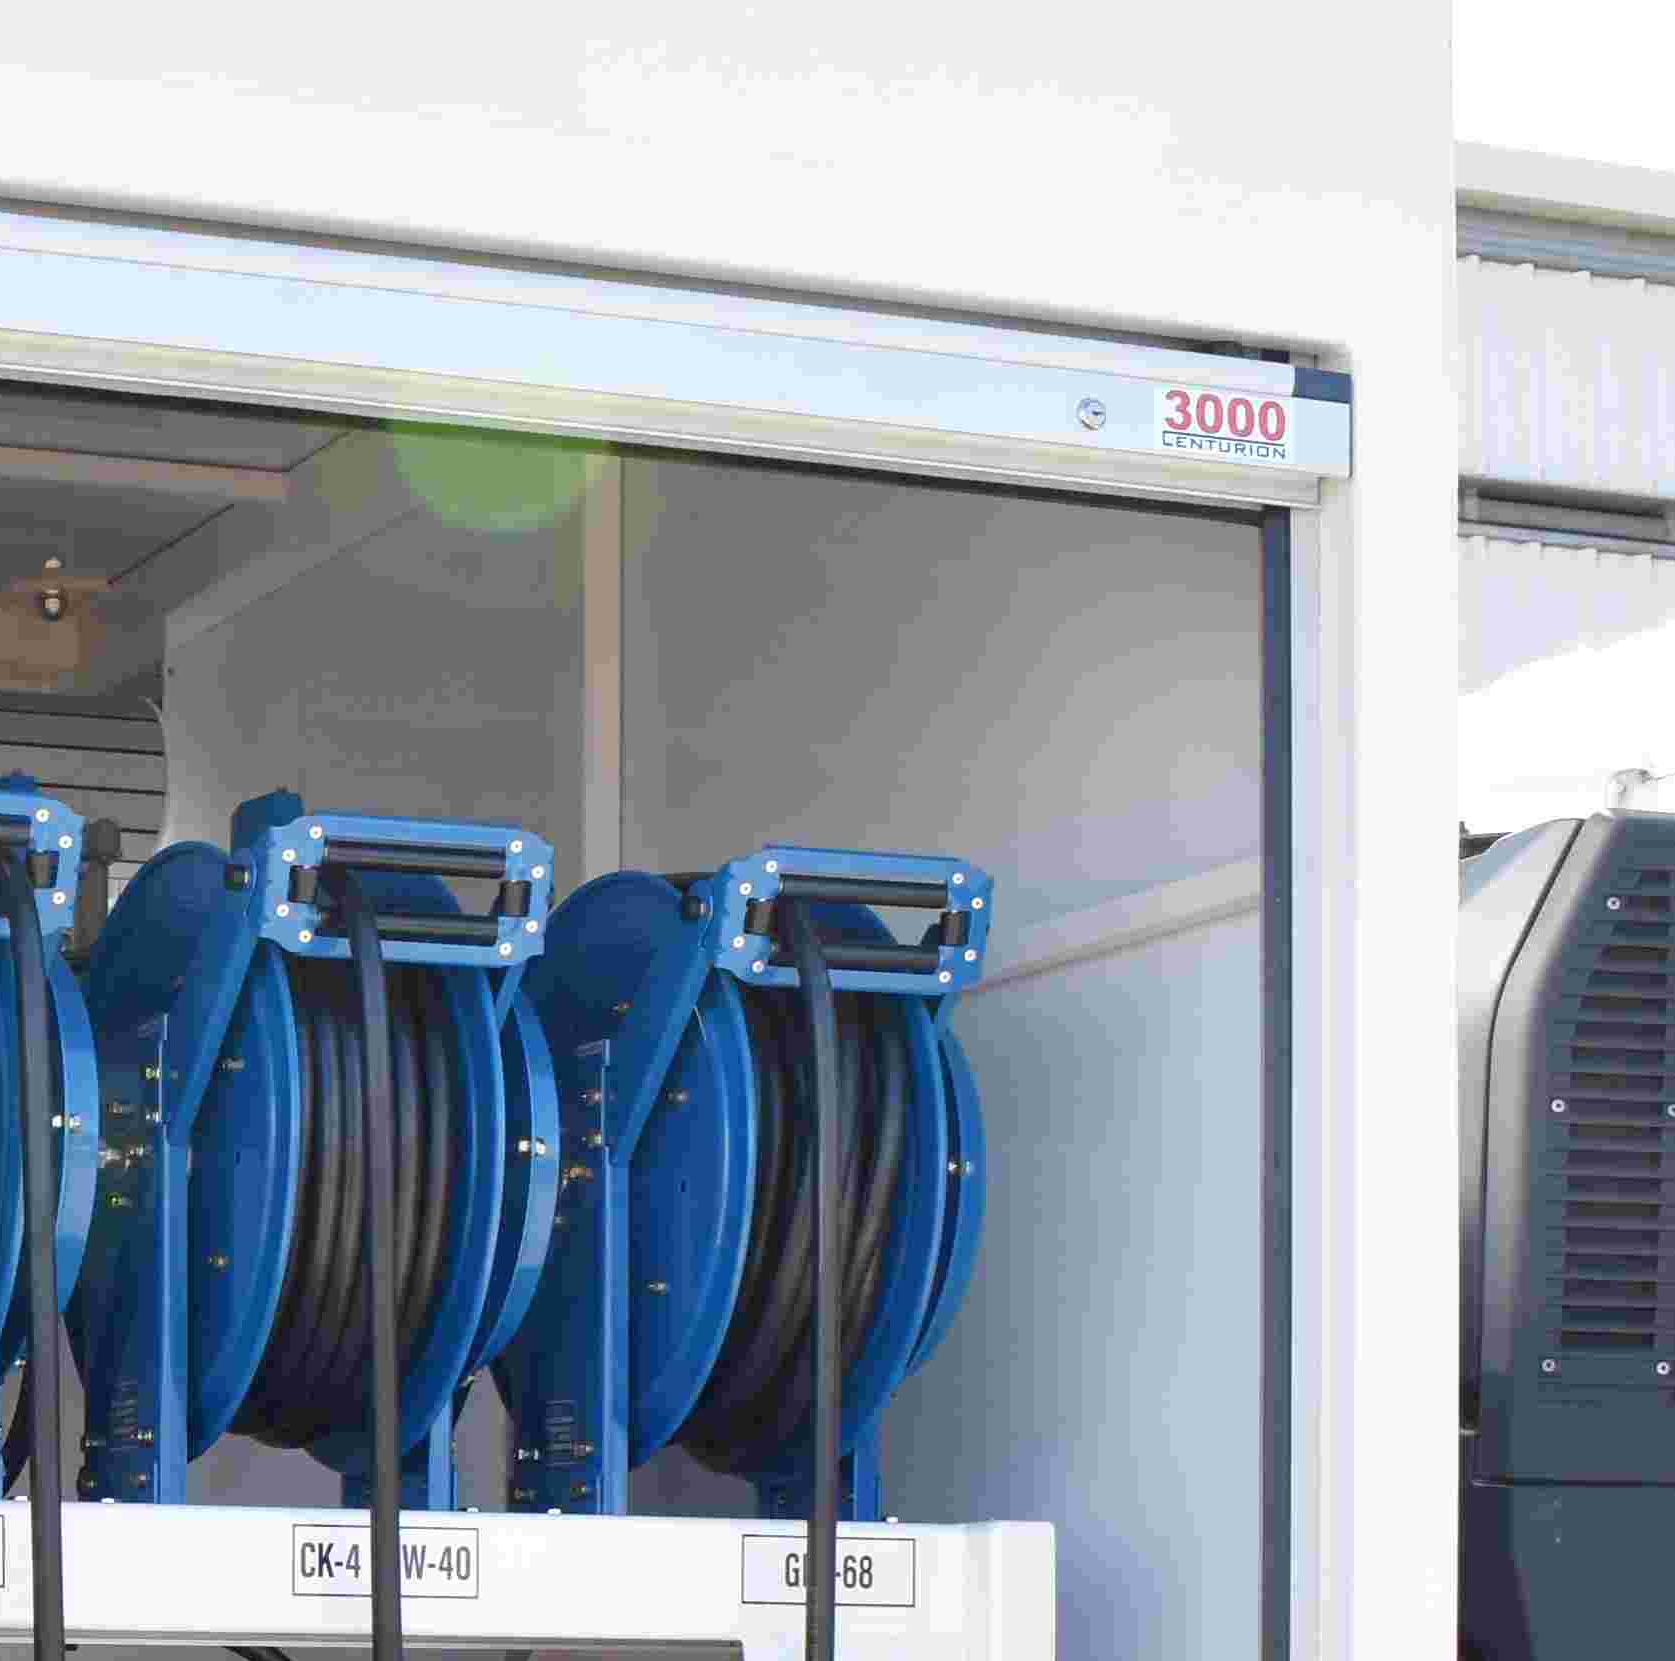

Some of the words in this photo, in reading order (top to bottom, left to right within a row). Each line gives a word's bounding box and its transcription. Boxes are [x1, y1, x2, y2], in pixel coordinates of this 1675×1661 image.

[1165, 389, 1286, 441] 3000
[1162, 430, 1286, 459] CENTURION
[300, 1542, 362, 1578] CK-4
